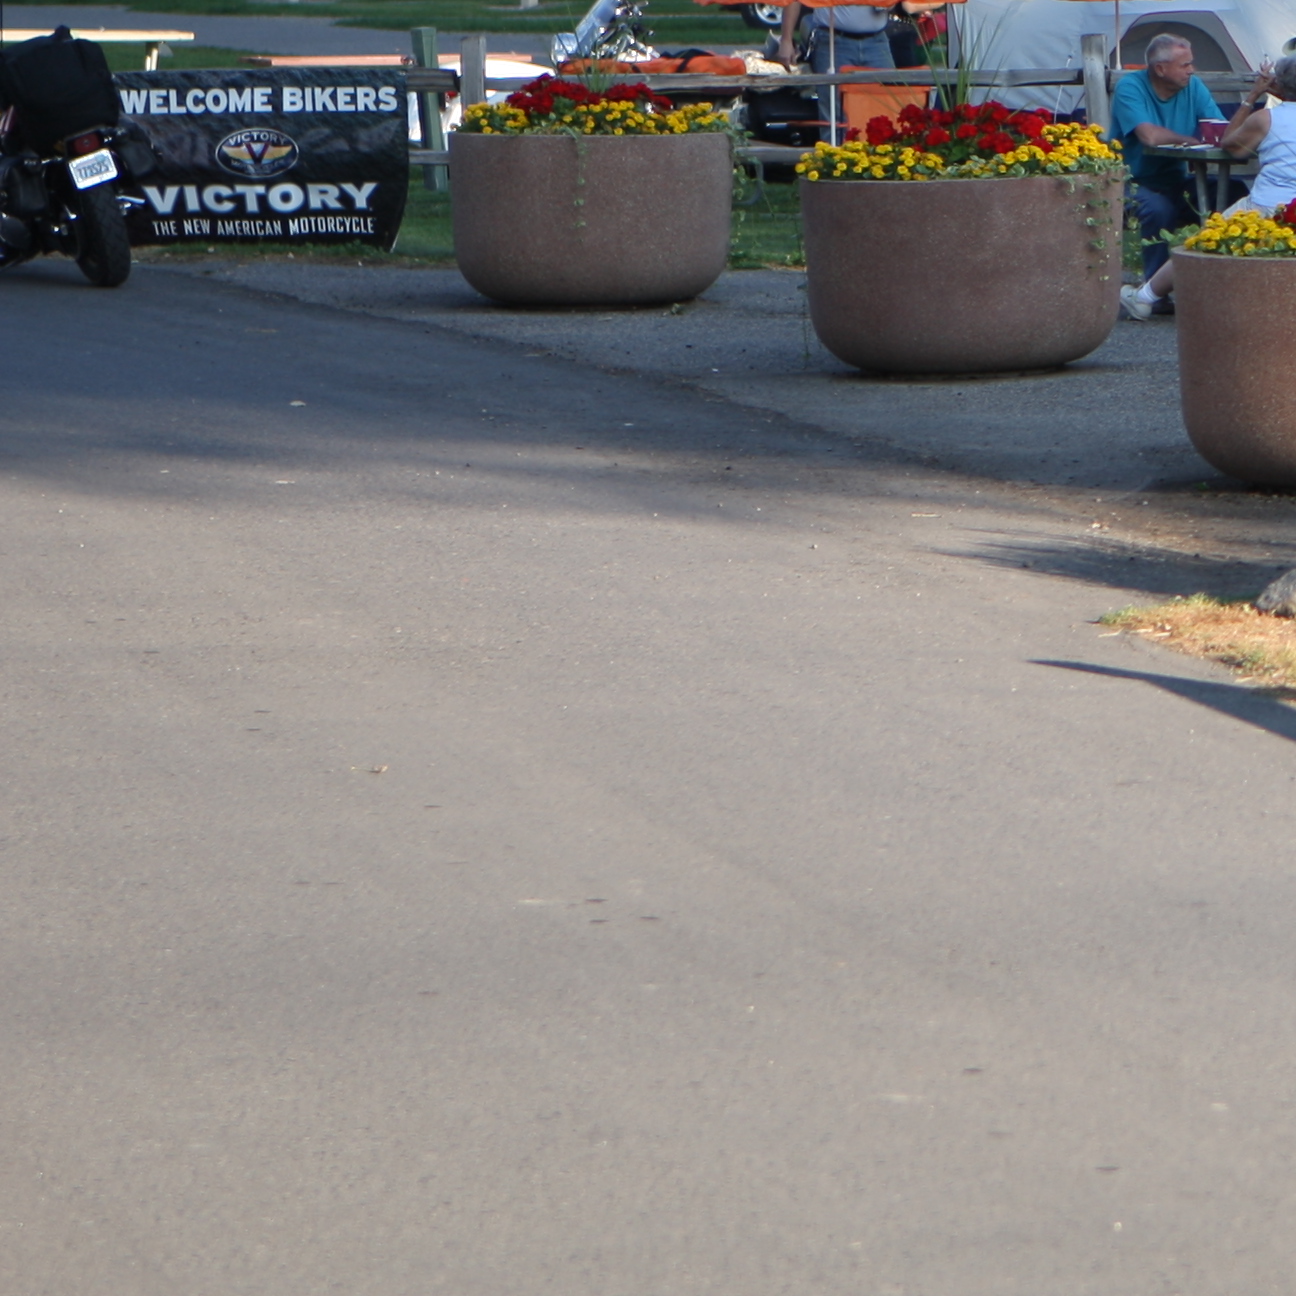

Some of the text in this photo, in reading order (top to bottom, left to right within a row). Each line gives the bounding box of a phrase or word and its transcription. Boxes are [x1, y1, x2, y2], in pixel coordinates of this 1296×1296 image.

[119, 86, 398, 116] WELCOME BIKERS
[228, 131, 287, 146] VICTORY
[142, 182, 379, 216] VICTORY
[152, 217, 375, 237] THE NEW AMERICAN MOTORCYCLE
